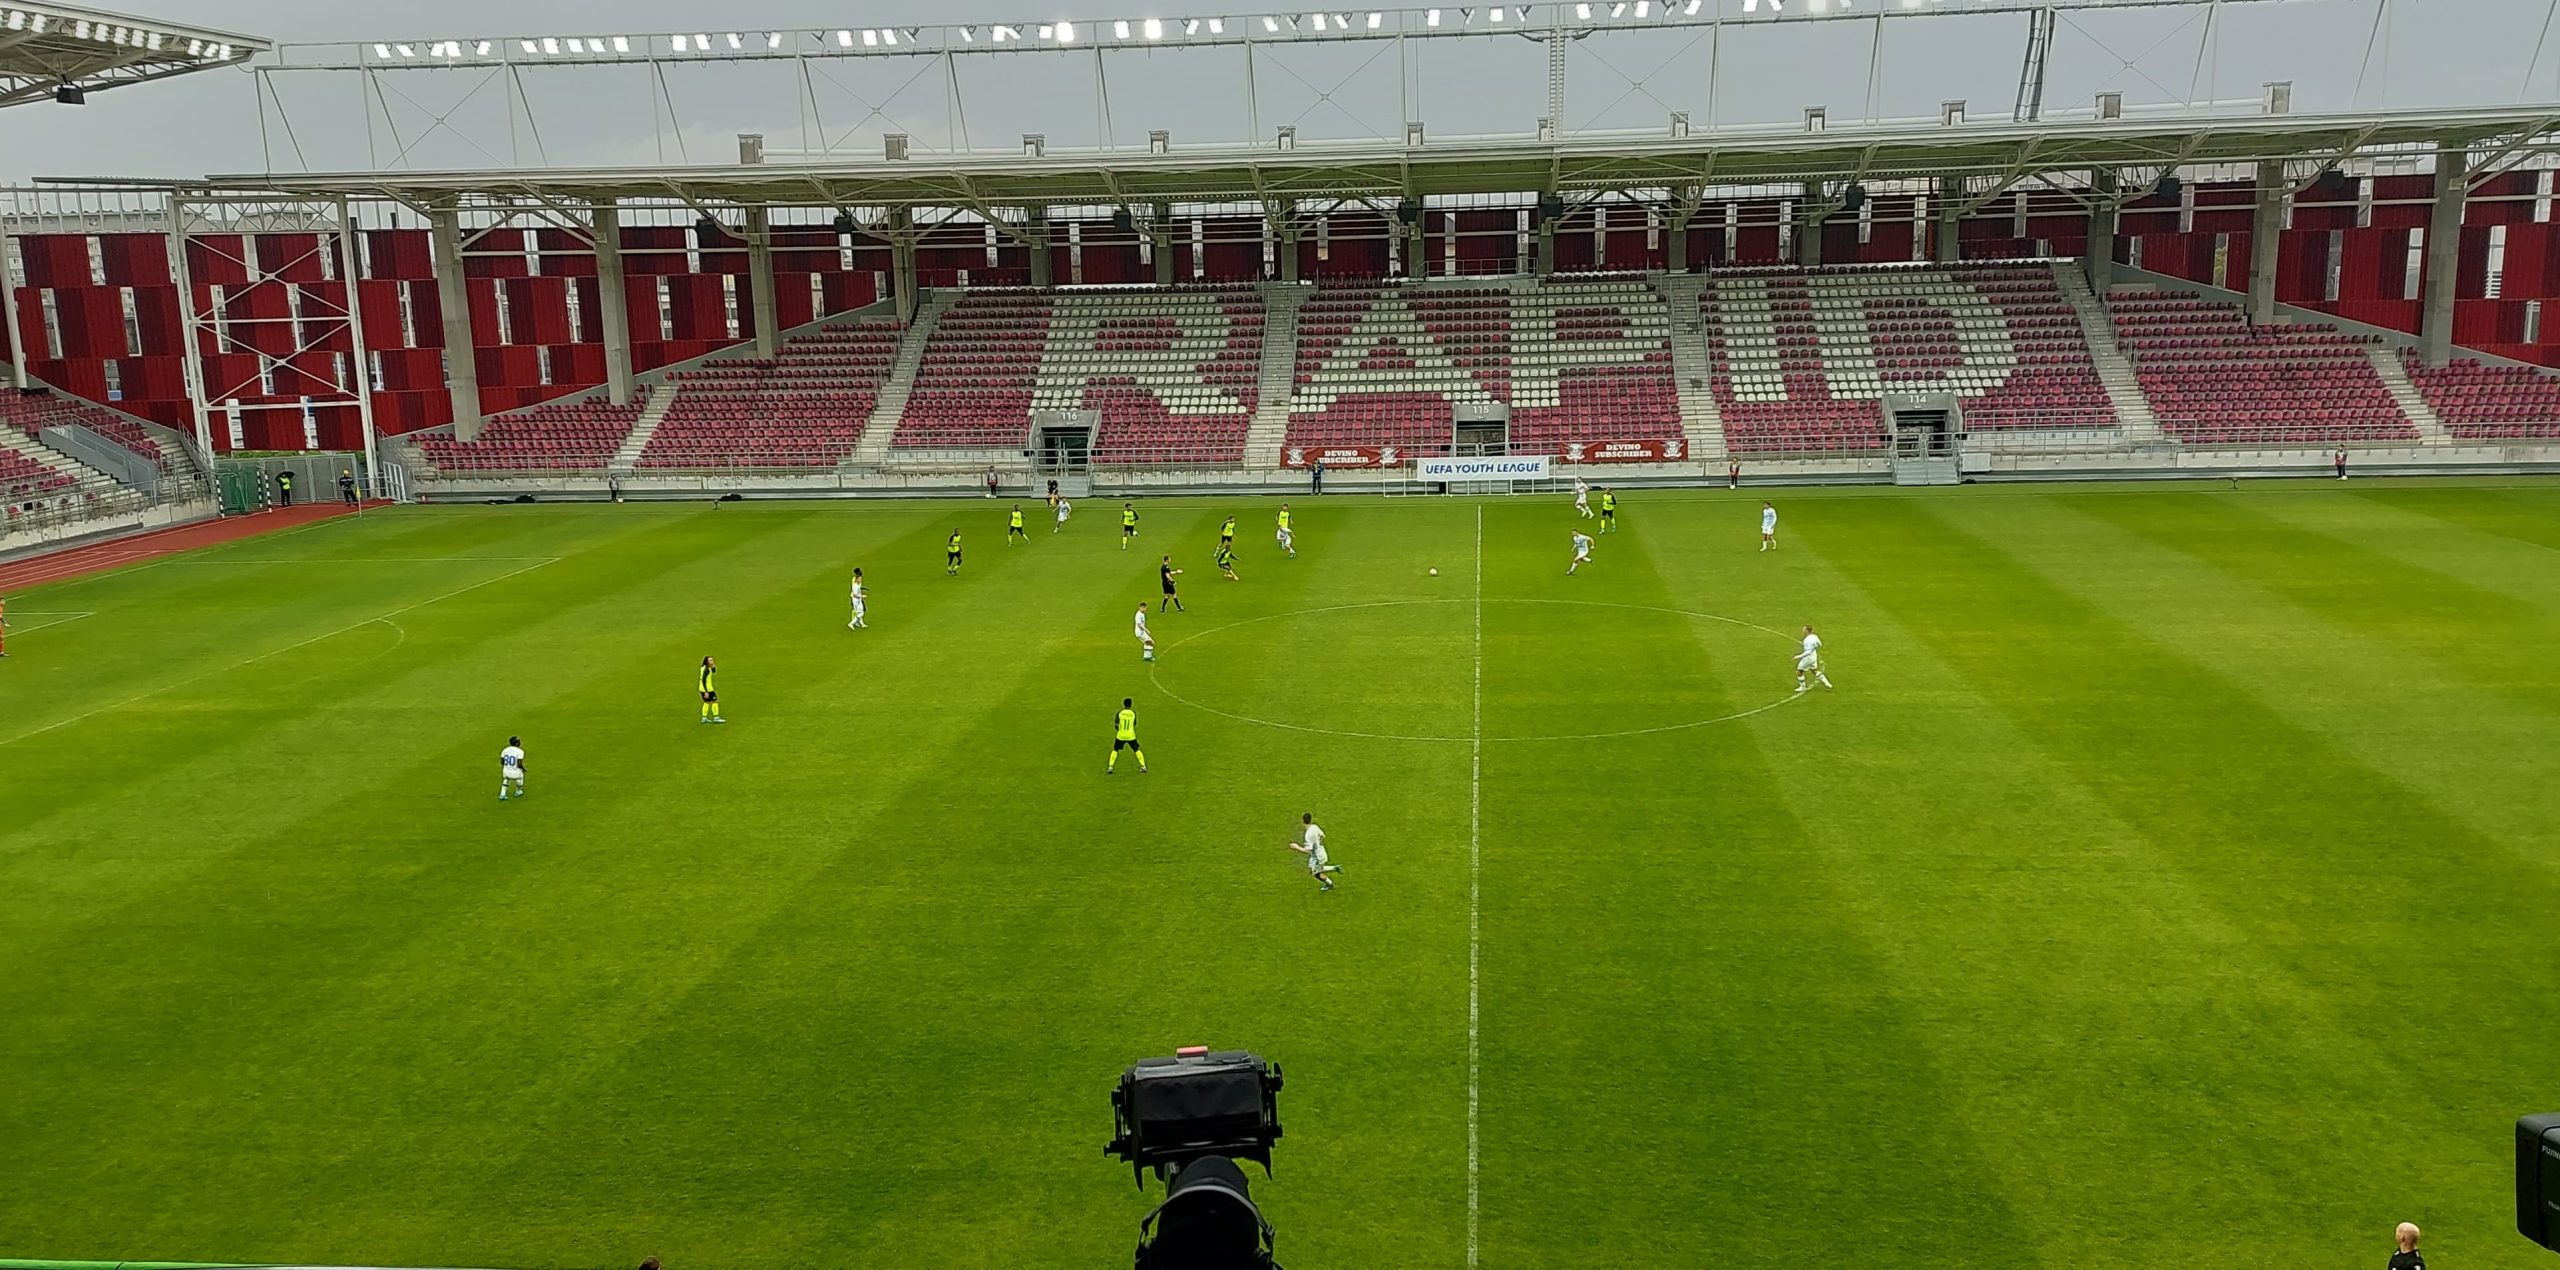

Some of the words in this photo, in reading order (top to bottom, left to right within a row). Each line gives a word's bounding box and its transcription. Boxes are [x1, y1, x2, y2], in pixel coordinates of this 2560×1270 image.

[1028, 274, 2019, 416] RAPID
[1908, 395, 1927, 403] 114
[1472, 405, 1490, 414] 115
[1060, 411, 1078, 420] 116
[1606, 443, 1641, 451] DEVINO
[1324, 449, 1358, 457] DEVINO
[1594, 450, 1652, 458] SUBSCRIBER
[1425, 464, 1453, 474] UEFA
[1455, 463, 1494, 473] YOUTH
[1497, 462, 1541, 472] LEAGUE
